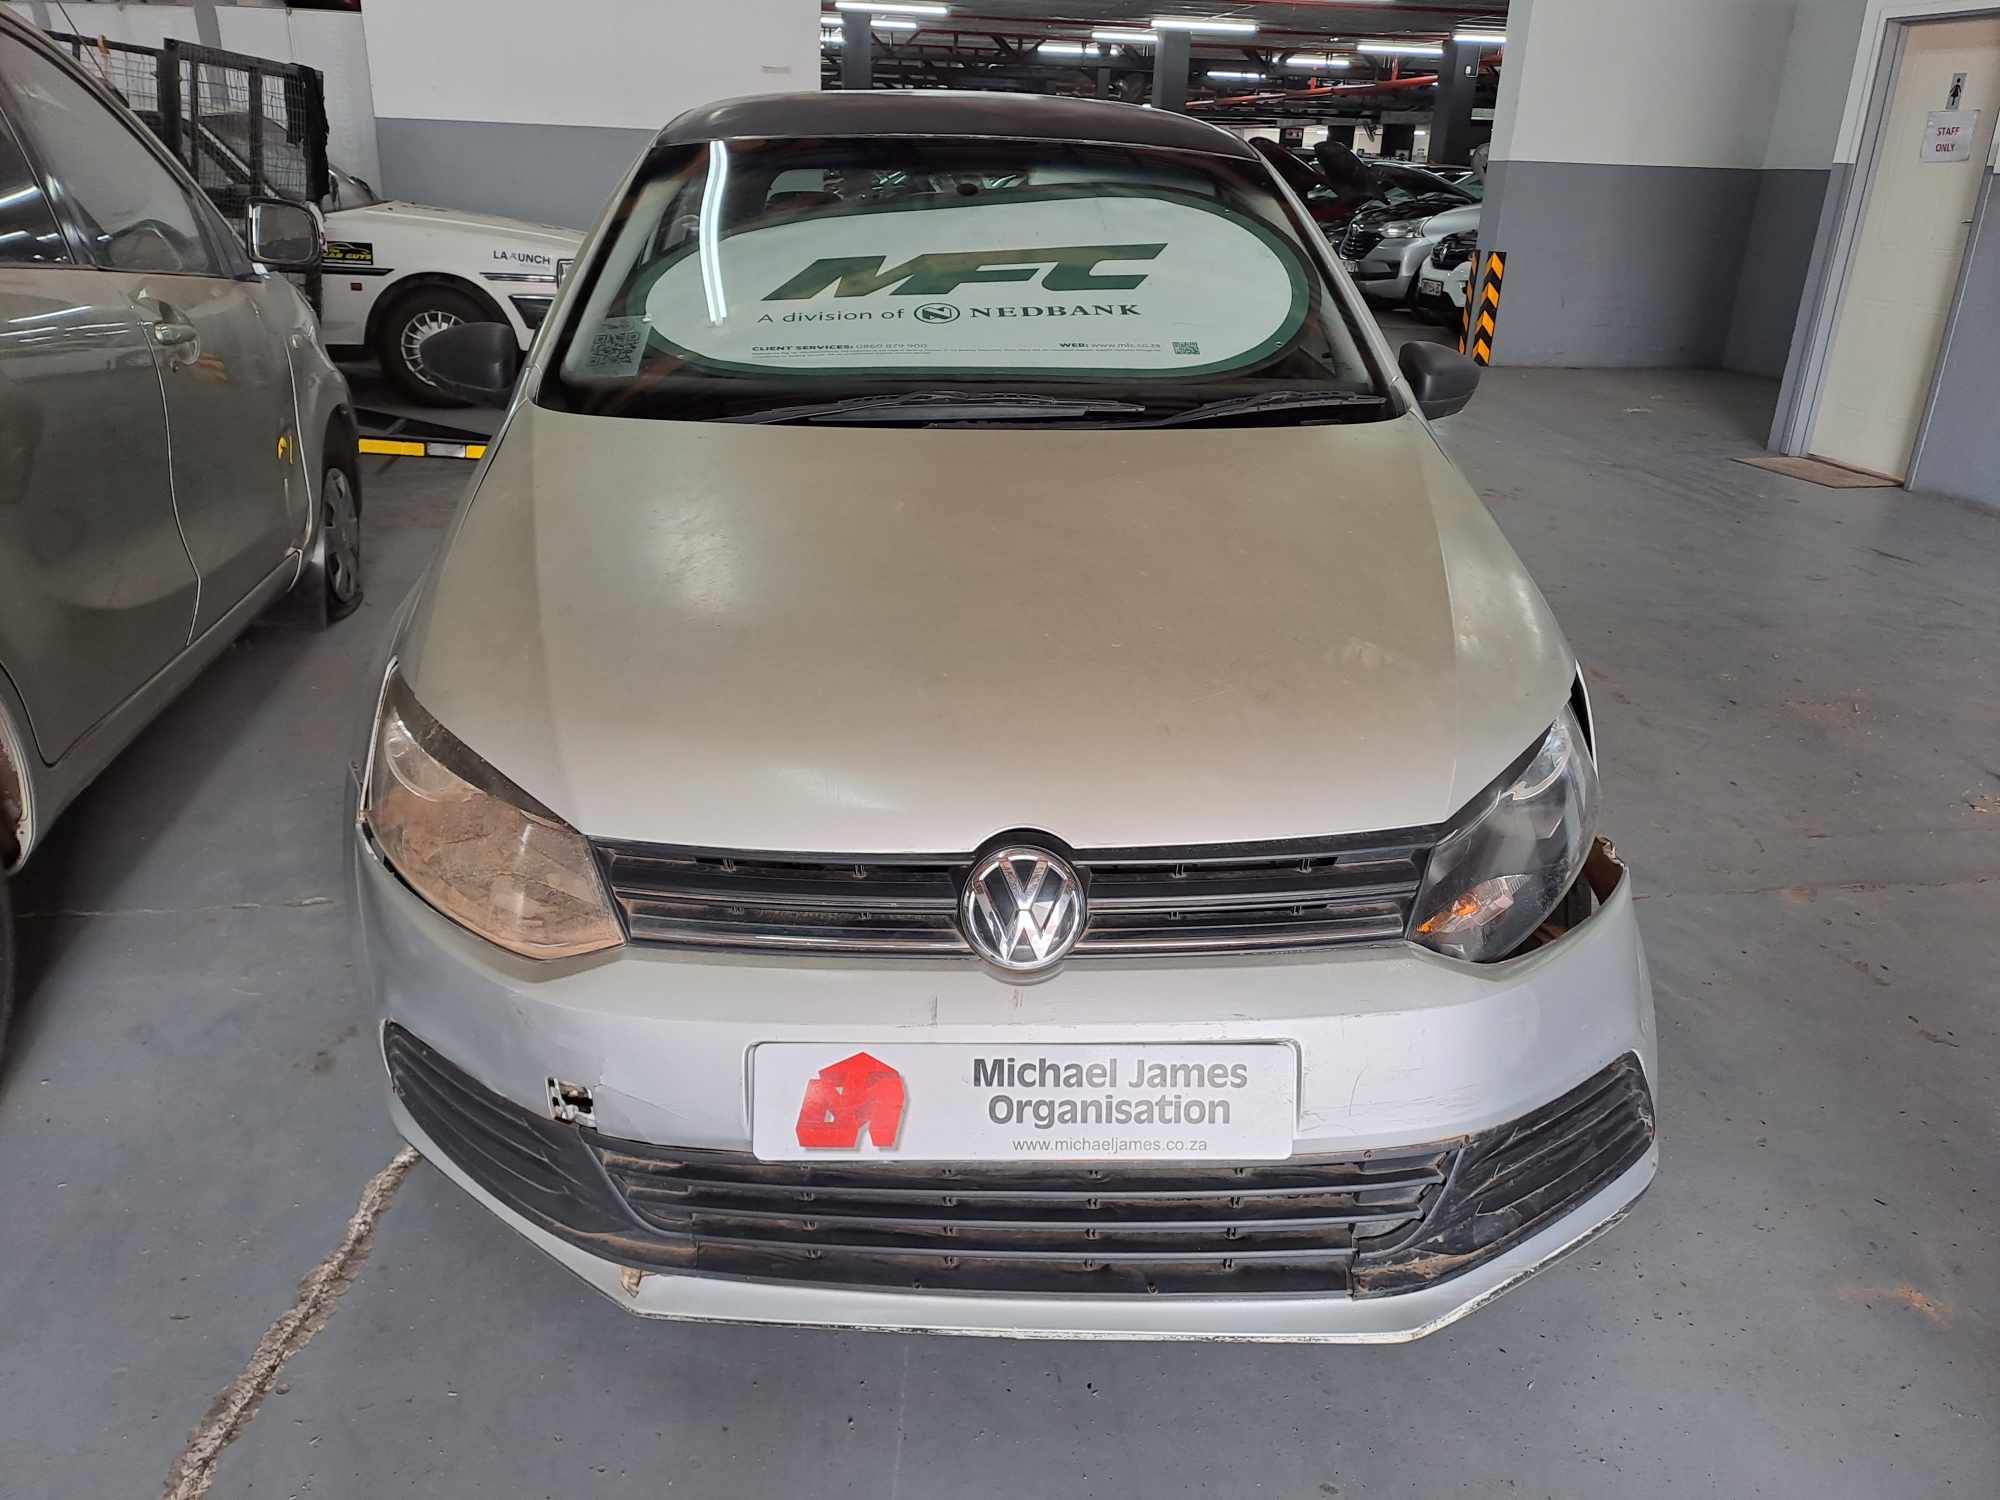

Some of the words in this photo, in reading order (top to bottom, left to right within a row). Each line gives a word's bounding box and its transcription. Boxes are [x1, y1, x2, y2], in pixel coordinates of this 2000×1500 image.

[1936, 126, 1960, 136] STAFF
[1935, 143, 1955, 152] ONLY
[761, 243, 1168, 301] MFC
[758, 314, 774, 323] A
[782, 311, 872, 322] division
[881, 308, 904, 320] of
[969, 304, 1141, 318] NEDBANK
[973, 1058, 1117, 1088] Michael
[1128, 1059, 1247, 1088] James
[988, 1094, 1230, 1129] Organisation
[1012, 1137, 1207, 1153] www.michaeljames.co.za
